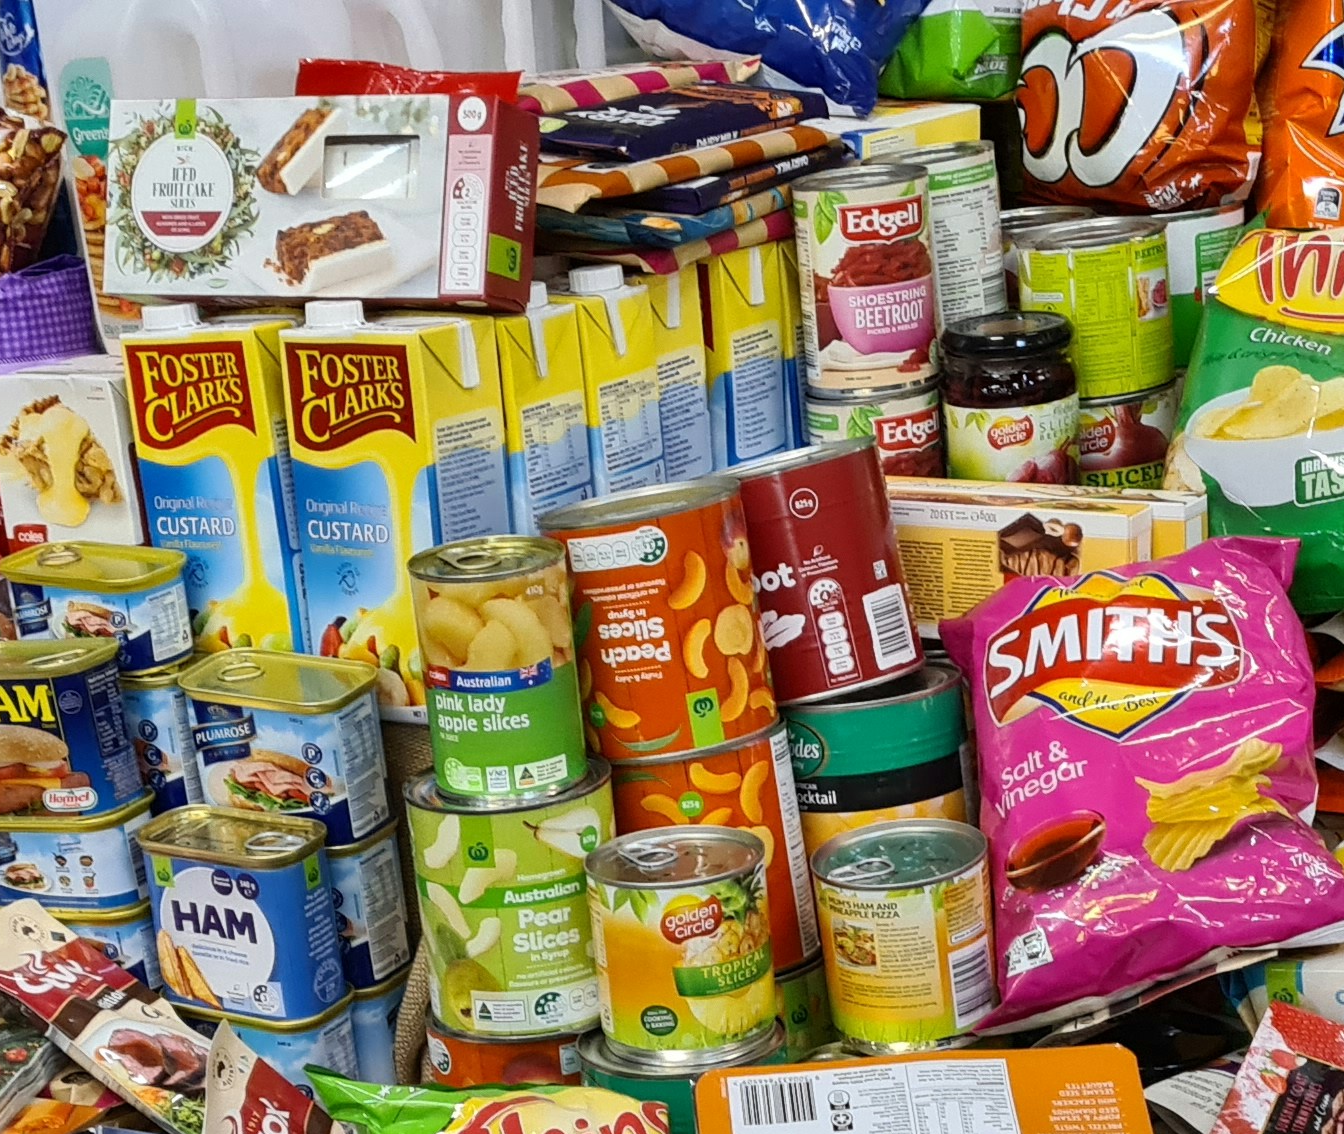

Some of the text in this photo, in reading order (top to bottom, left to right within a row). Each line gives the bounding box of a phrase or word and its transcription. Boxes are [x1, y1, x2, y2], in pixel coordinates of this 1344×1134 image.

[171, 165, 196, 183] ICED
[151, 180, 216, 199] FRUIT CAKE
[846, 202, 919, 235] Edgell
[847, 284, 926, 308] SHOESTRING
[855, 301, 926, 328] BEETROOT
[1248, 326, 1331, 355] Chicken
[135, 351, 239, 403] FOSTER
[156, 515, 236, 537] CUSTARD
[307, 520, 390, 543] CUSTARD
[598, 616, 664, 640] Slices
[601, 640, 672, 665] Peach
[988, 604, 1237, 700] SMITH'S
[455, 673, 512, 689] Australian
[436, 692, 506, 715] pink lady
[195, 722, 253, 744] PLUMROSE
[437, 710, 530, 735] apple slices
[1002, 756, 1043, 790] Salt
[49, 792, 89, 803] Hormel
[994, 757, 1088, 817] vinegar
[504, 880, 580, 906] Australian
[173, 899, 255, 940] HAM
[518, 907, 570, 929] Pear
[663, 906, 719, 932] golden
[674, 919, 717, 939] circle
[513, 926, 580, 952] Slices
[700, 951, 768, 983] TROPICAL
[717, 970, 757, 988] SLICES
